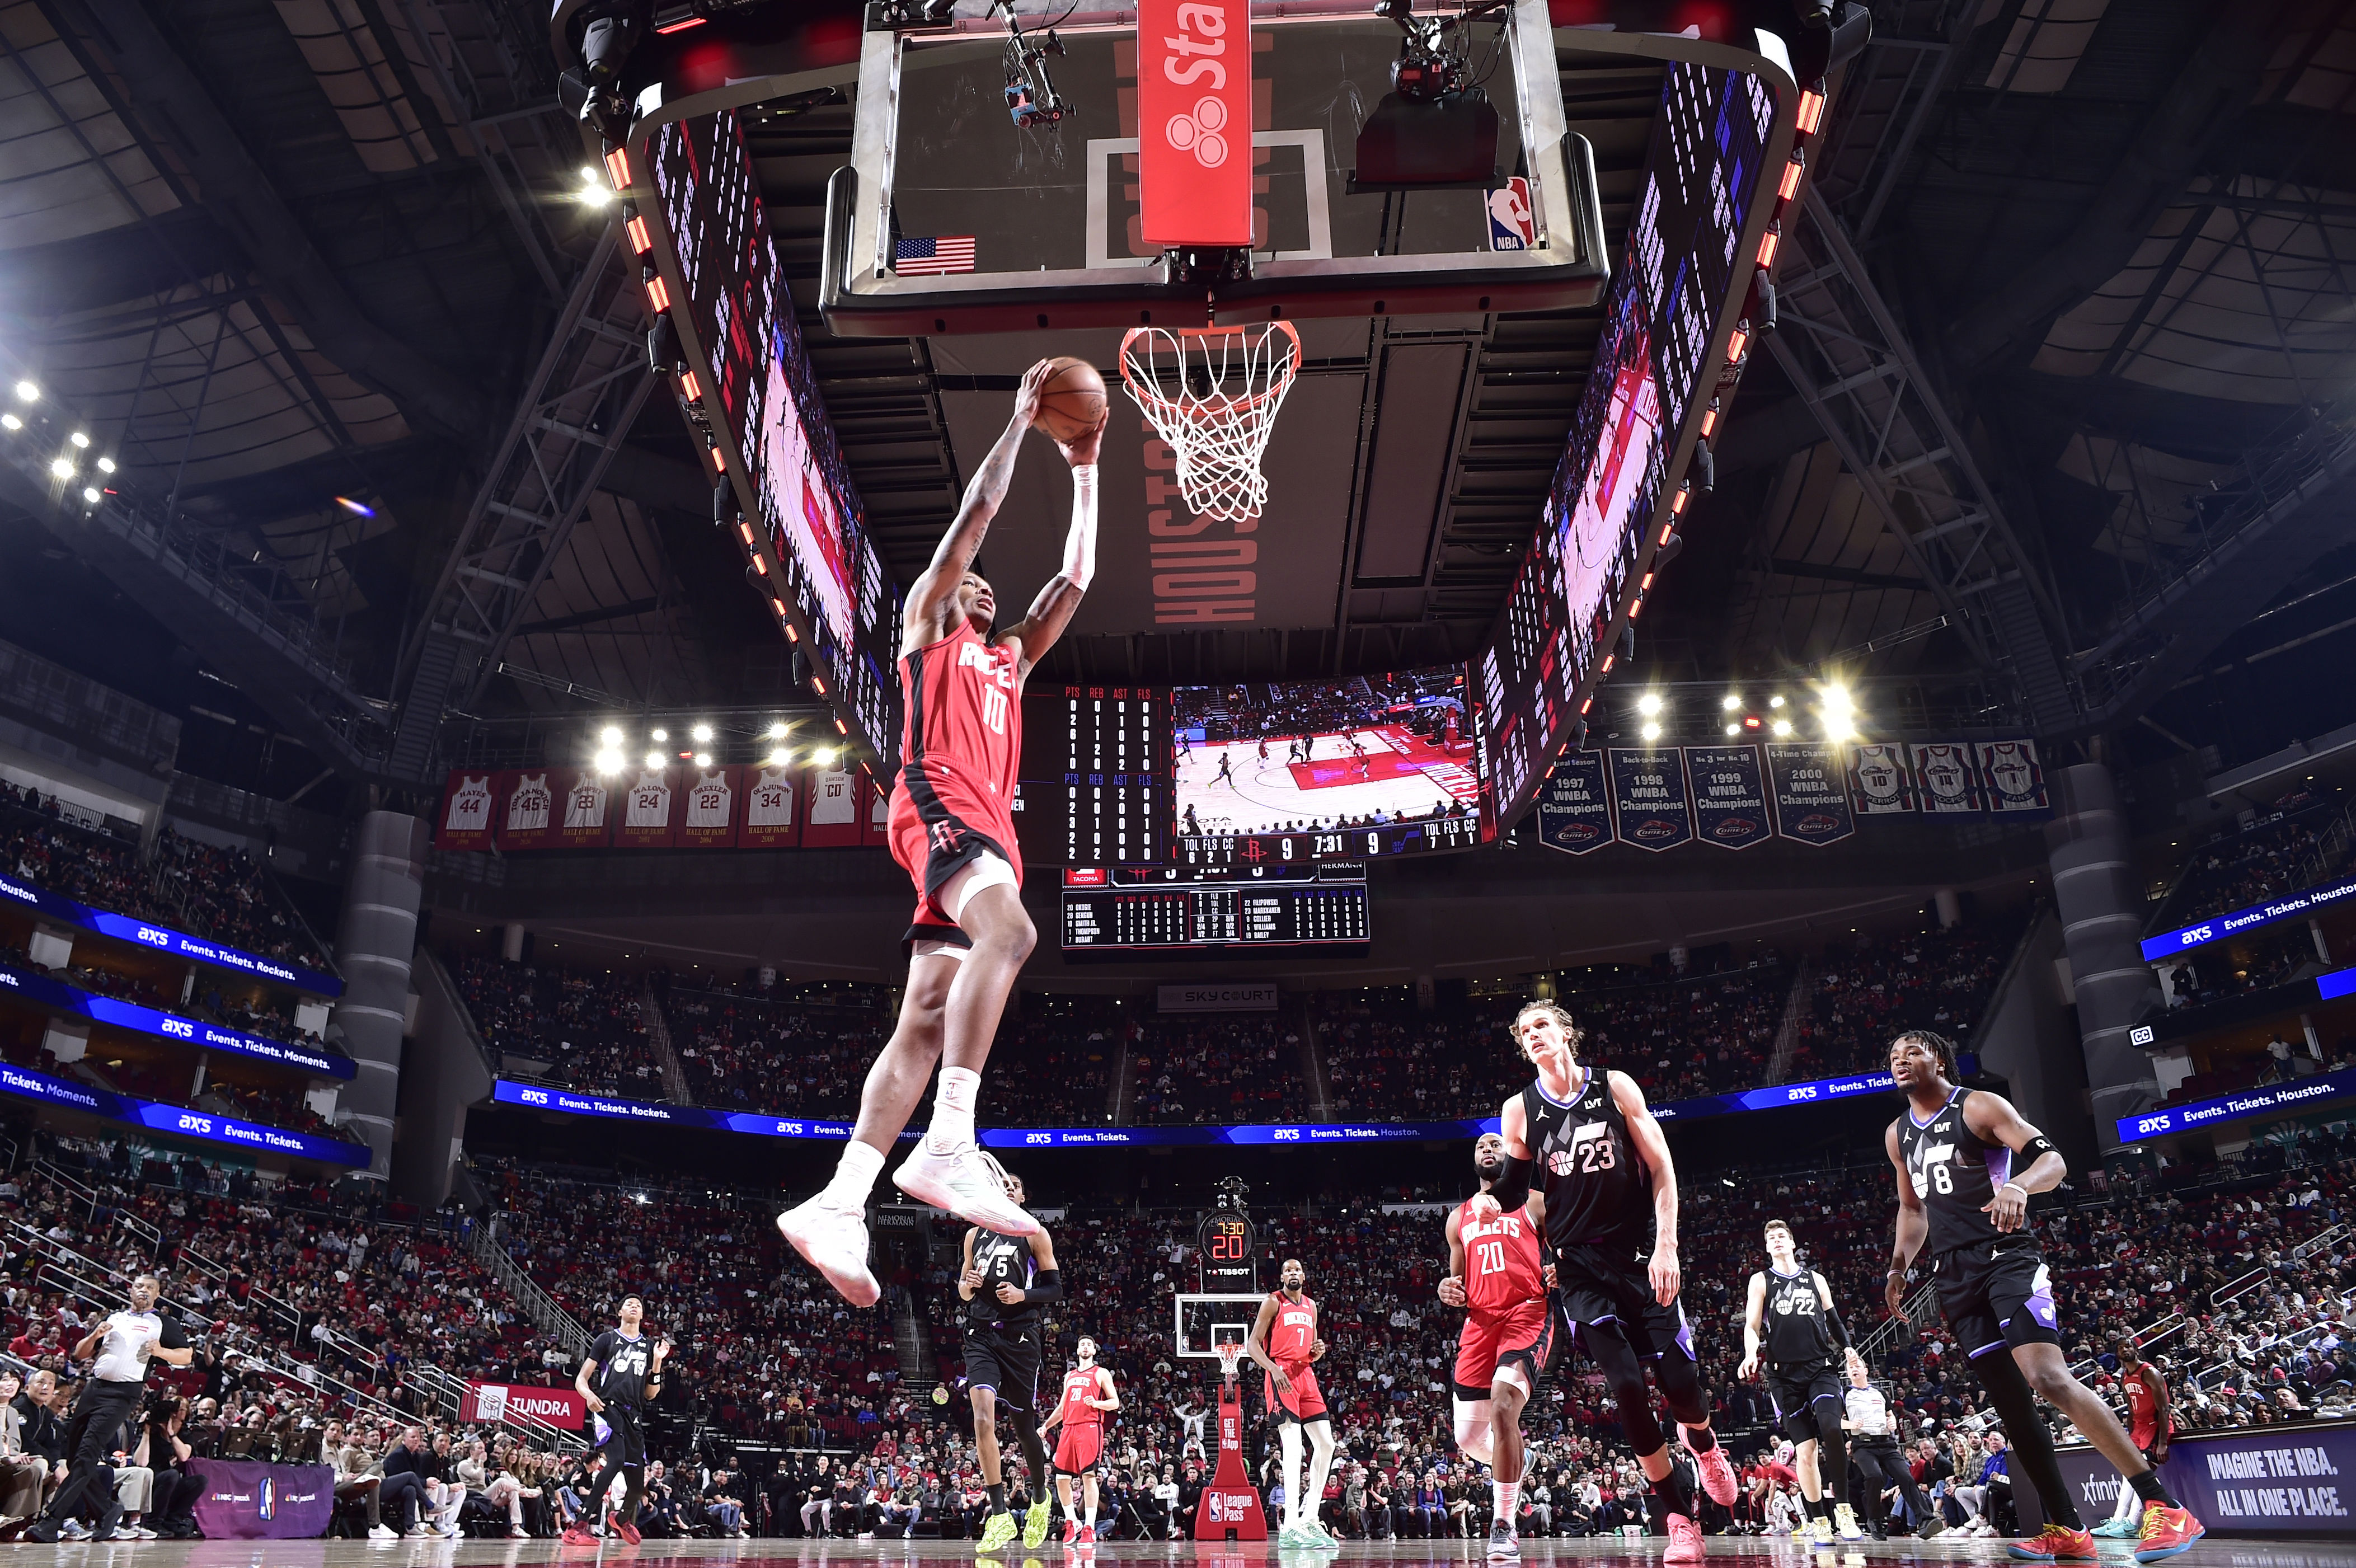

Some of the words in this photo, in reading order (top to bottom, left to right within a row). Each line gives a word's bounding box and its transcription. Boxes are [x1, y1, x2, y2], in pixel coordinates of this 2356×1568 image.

[1497, 236, 1519, 250] NBA
[1066, 687, 1080, 697] PTS
[1090, 688, 1104, 698] REB
[1114, 688, 1127, 699] AST
[1138, 689, 1150, 700] FLS
[983, 683, 1007, 735] 10
[1739, 753, 1749, 762] 10
[1065, 773, 1078, 785] PTS
[1090, 774, 1103, 785] REB
[1114, 774, 1128, 785] AST
[1139, 775, 1151, 786] FLS
[1634, 775, 1663, 785] 1998
[1711, 773, 1742, 783] 1999
[1791, 769, 1823, 779] 2000
[1556, 778, 1584, 788] 1997
[1790, 781, 1829, 792] WNBA
[1872, 775, 1887, 787] 10
[459, 790, 487, 799] HAYES
[573, 787, 604, 796] MURPHY
[633, 786, 667, 795] MALONE
[693, 785, 728, 795] DREXLER
[753, 785, 791, 795] OLAJUWON
[1553, 791, 1590, 801] WNBA
[1631, 787, 1669, 798] WNBA
[1707, 785, 1747, 796] WNBA
[578, 795, 594, 809] 23
[639, 794, 659, 808] 24
[700, 795, 719, 809] 22
[761, 793, 781, 808] 34
[1780, 795, 1844, 806] Champions
[1866, 794, 1900, 804] PERROT
[2006, 792, 2031, 802] FANS
[459, 799, 481, 813] 44
[520, 797, 541, 811] 45
[1542, 803, 1604, 815] Champions
[1620, 800, 1684, 812] Champions
[1697, 798, 1761, 810] Champions
[1424, 823, 1440, 836] TOL
[1444, 821, 1459, 834] FLS
[1464, 819, 1476, 833] CC
[1184, 839, 1199, 851] TOL
[1203, 839, 1217, 851] FLS
[1223, 838, 1233, 849] CC
[1282, 838, 1292, 860] 9
[1315, 834, 1343, 852] 7:31
[1368, 833, 1378, 854] 9
[1430, 836, 1435, 848] 7
[1450, 834, 1454, 846] 1
[1468, 832, 1473, 844] 1
[1189, 852, 1195, 863] 6
[1208, 851, 1213, 863] 2
[1227, 851, 1231, 862] 1
[1072, 875, 1100, 884] TACOMA
[2224, 914, 2264, 929] Events.
[2265, 900, 2309, 917] Tickets.
[181, 940, 216, 958] Events.
[219, 950, 254, 969] Tickets.
[257, 961, 295, 980] Rockets.
[1185, 992, 1218, 1002] SKY
[2134, 1030, 2150, 1042] CC
[206, 1031, 242, 1048] Events.
[245, 1040, 281, 1057] Tickets.
[284, 1050, 330, 1069] Moments.
[3, 1071, 44, 1092] Tickets.
[46, 1084, 97, 1106] Moments.
[1829, 1082, 1865, 1093] Events.
[1866, 1077, 1895, 1088] Ticke
[559, 1097, 592, 1110] Events.
[594, 1102, 629, 1114] Tickets.
[632, 1106, 670, 1118] Rockets.
[1584, 1097, 1602, 1110] LVT
[2184, 1107, 2226, 1121] Events.
[2227, 1097, 2274, 1112] Tickets.
[2277, 1085, 2334, 1102] Houston.
[1650, 1109, 1677, 1119] ckets.
[814, 1125, 846, 1134] Events.
[1381, 1127, 1420, 1137] Houston.
[225, 1125, 262, 1142] Events.
[265, 1133, 303, 1149] Tickets.
[1578, 1139, 1615, 1173] 23
[1933, 1165, 1953, 1195] 8
[1218, 1223, 1244, 1234] 7:30
[1213, 1236, 1242, 1259] 20
[1477, 1241, 1505, 1275] 20
[996, 1257, 1007, 1277] 5
[1795, 1298, 1815, 1316] 22
[1297, 1328, 1304, 1346] 7
[633, 1360, 646, 1377] 19
[512, 1396, 571, 1417] TUNDRA
[1224, 1418, 1235, 1428] GET
[1224, 1429, 1236, 1438] THE
[1227, 1439, 1238, 1450] App
[2207, 1451, 2267, 1480] IMAGINE
[2266, 1448, 2296, 1477] THE
[2293, 1446, 2338, 1476] NBA.
[1224, 1493, 1252, 1509] League
[2216, 1489, 2242, 1517] ALL
[2240, 1489, 2258, 1517] IN
[2258, 1487, 2294, 1517] ONE
[2291, 1486, 2348, 1517] PLACE.
[1224, 1508, 1244, 1521] Pass
